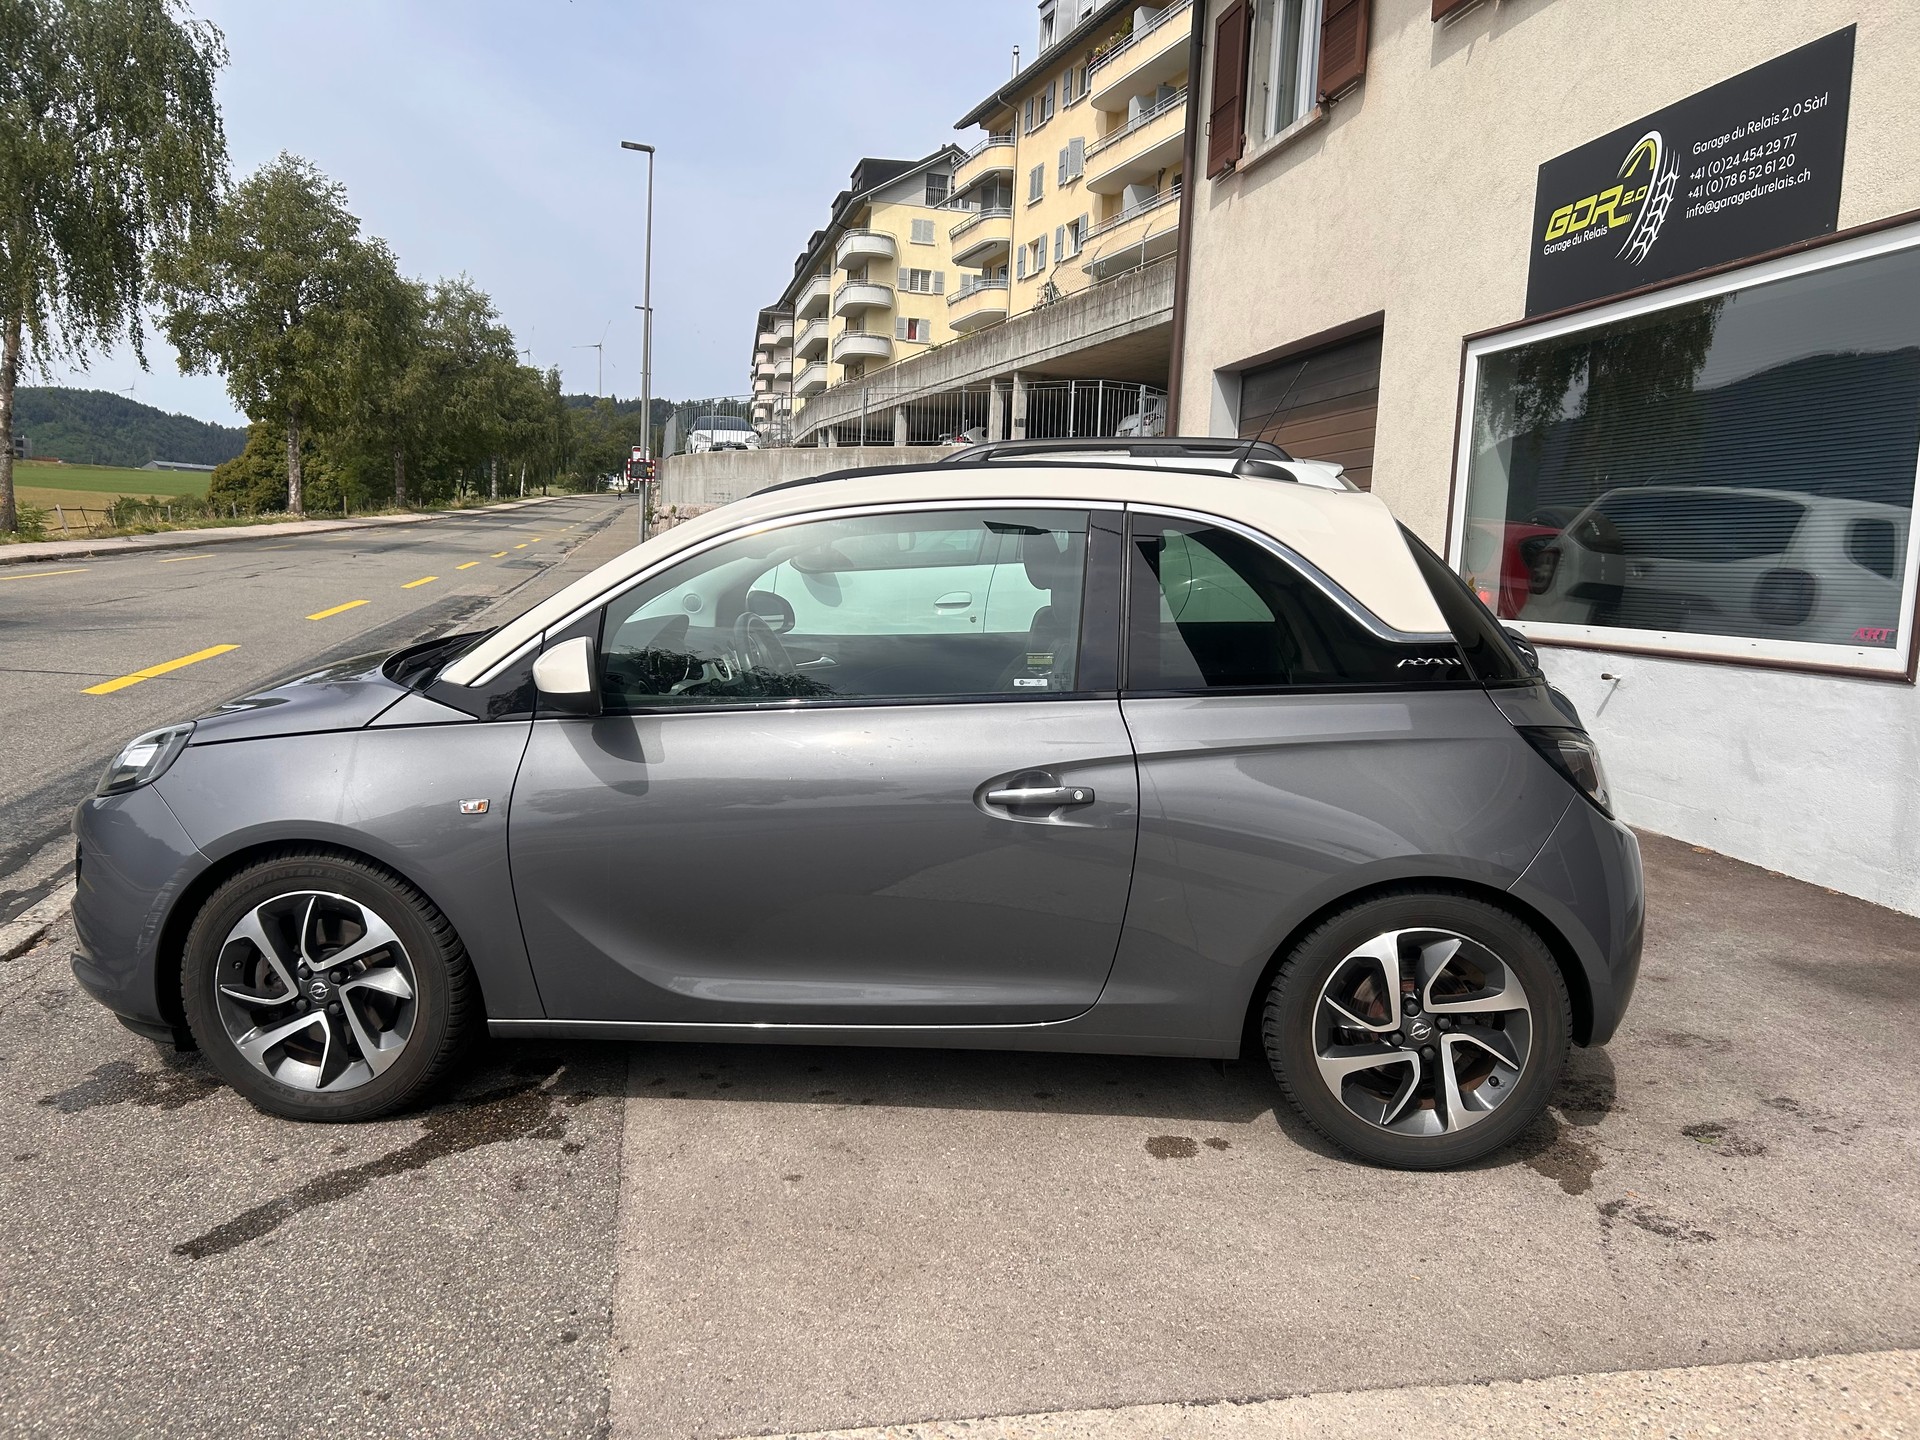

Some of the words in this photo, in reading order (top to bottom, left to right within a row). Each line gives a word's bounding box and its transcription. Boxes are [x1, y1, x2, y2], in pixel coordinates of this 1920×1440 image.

[1692, 133, 1730, 154] Garage
[1731, 126, 1745, 140] du
[1746, 112, 1780, 134] Relais
[1781, 103, 1801, 121] 2.0
[1803, 91, 1828, 113] Sàrl
[1687, 184, 1703, 198] +41
[1764, 159, 1777, 175] 61
[1778, 153, 1795, 170] 20
[1689, 166, 1705, 180] +41
[1741, 145, 1764, 163] 454
[1765, 139, 1781, 155] 29
[1783, 132, 1798, 149] 77
[1545, 184, 1630, 241] GDR
[1621, 185, 1648, 206] 2.0
[1685, 167, 1811, 219] info@garagedurelais.ch
[1544, 239, 1571, 255] Garage
[1572, 231, 1582, 245] du
[1583, 225, 1608, 241] Relais
